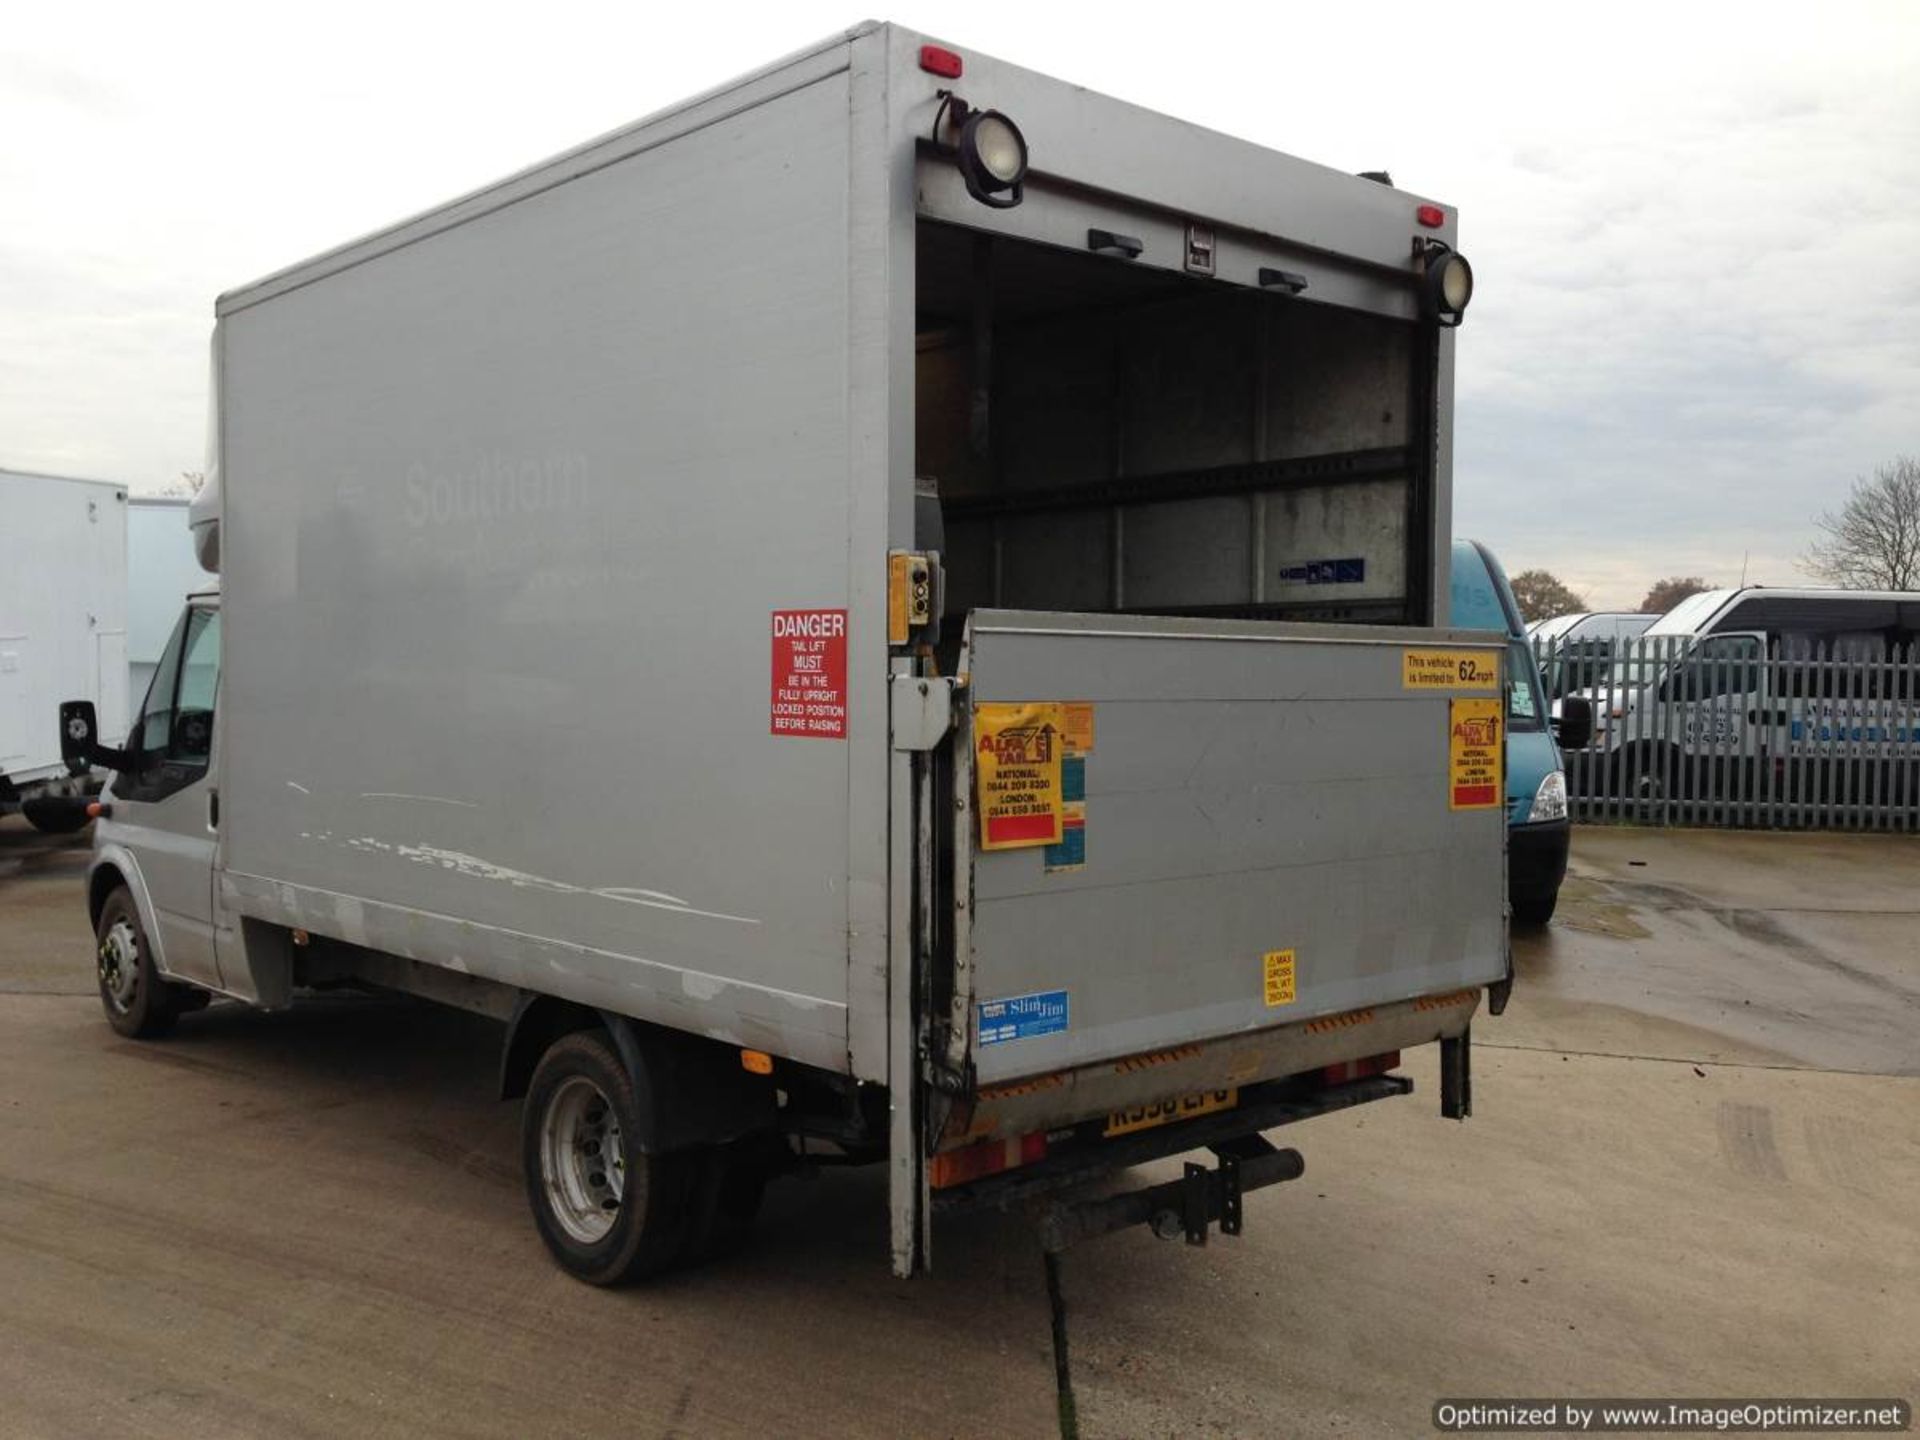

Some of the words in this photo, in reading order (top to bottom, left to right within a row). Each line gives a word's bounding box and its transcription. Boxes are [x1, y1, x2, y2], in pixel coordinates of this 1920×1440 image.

[404, 448, 588, 528] Southern
[773, 614, 844, 637] DANGER
[791, 641, 807, 652] TAIL
[809, 641, 826, 651] LIFT
[794, 655, 823, 669] MUST
[1408, 655, 1425, 668] This
[1427, 656, 1455, 669] vehicle
[1459, 660, 1476, 681] 62
[1476, 669, 1494, 685] mph
[788, 676, 799, 686] BE
[801, 676, 811, 687] IN
[813, 676, 828, 687] THE
[1408, 671, 1417, 683] is
[1419, 671, 1446, 684] limited
[1446, 672, 1455, 684] to
[778, 689, 801, 700] FULLY
[803, 690, 838, 702] UPRIGHT
[773, 704, 804, 715] LOCKED
[807, 705, 844, 717] POSITION
[775, 718, 806, 730] BEFORE
[809, 719, 841, 732] RAISING
[1010, 998, 1040, 1015] Slim
[1039, 1003, 1064, 1017] Jim
